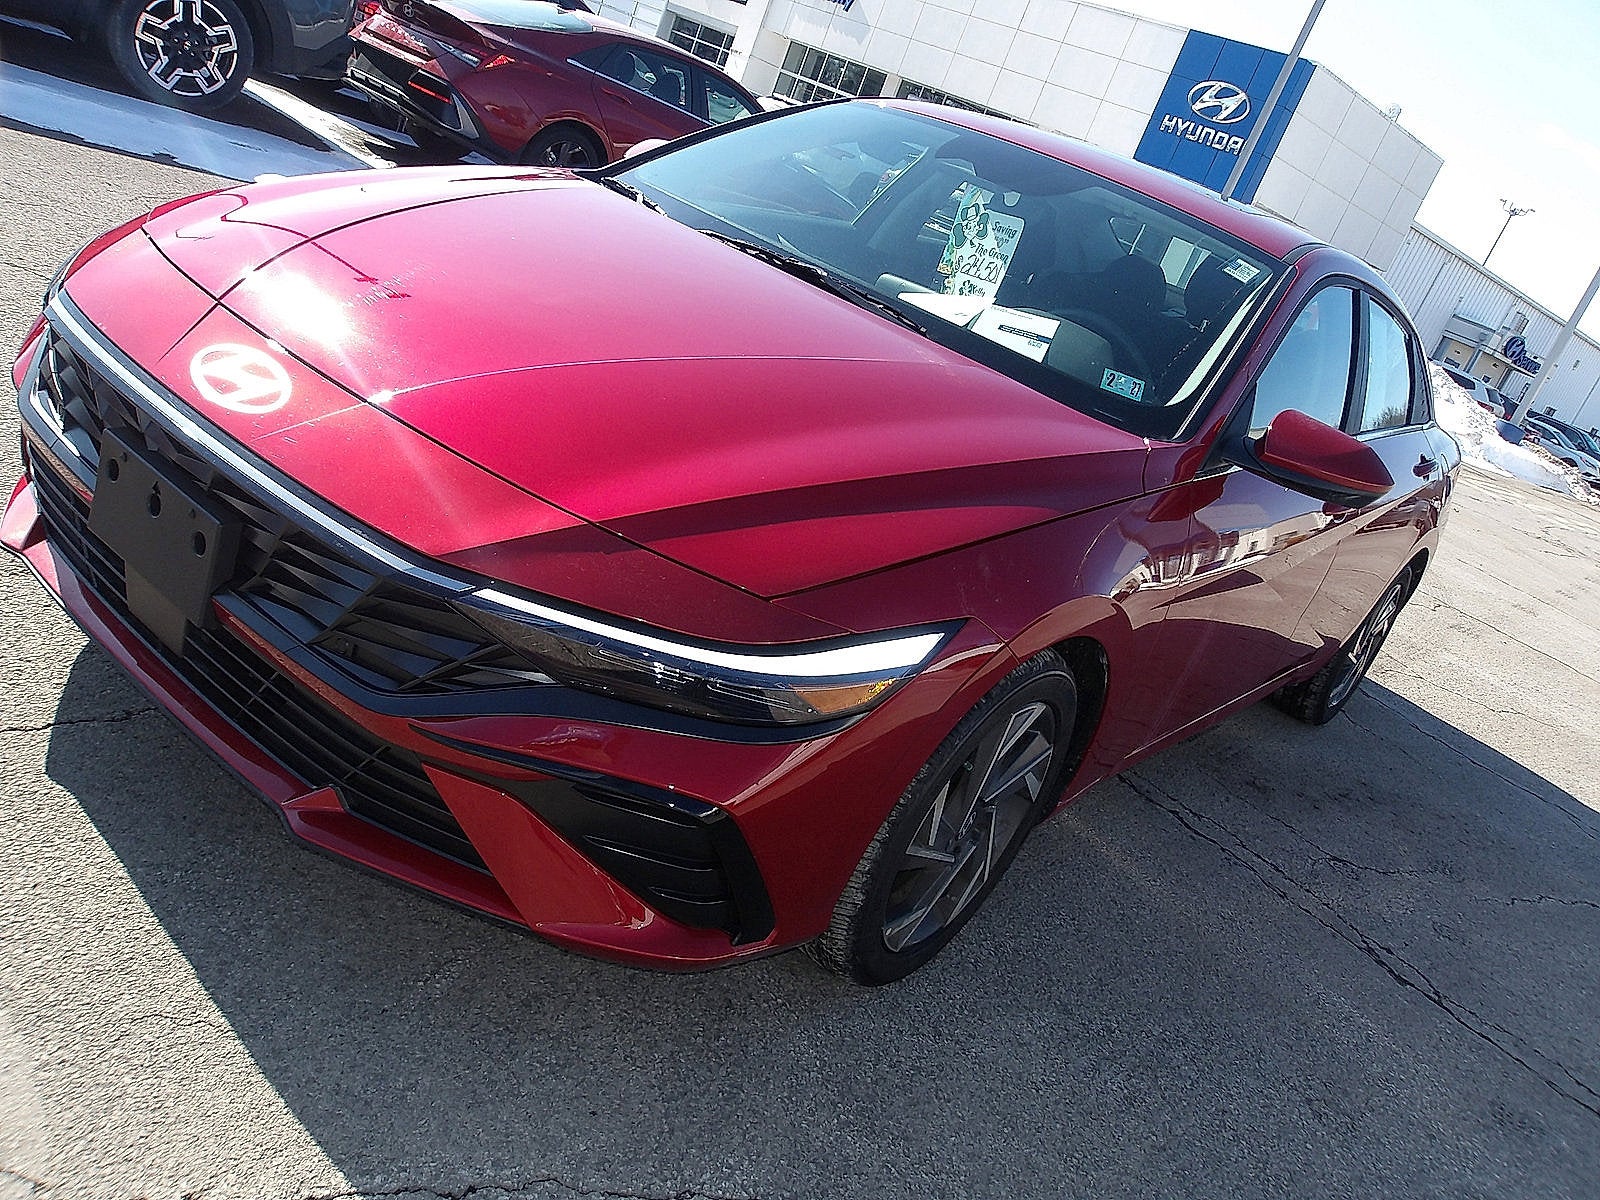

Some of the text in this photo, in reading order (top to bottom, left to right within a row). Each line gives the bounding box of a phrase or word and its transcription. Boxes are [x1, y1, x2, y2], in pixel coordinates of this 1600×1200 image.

[1159, 114, 1246, 155] HYUNDA
[992, 221, 1017, 239] Saving
[974, 243, 1009, 264] The Green
